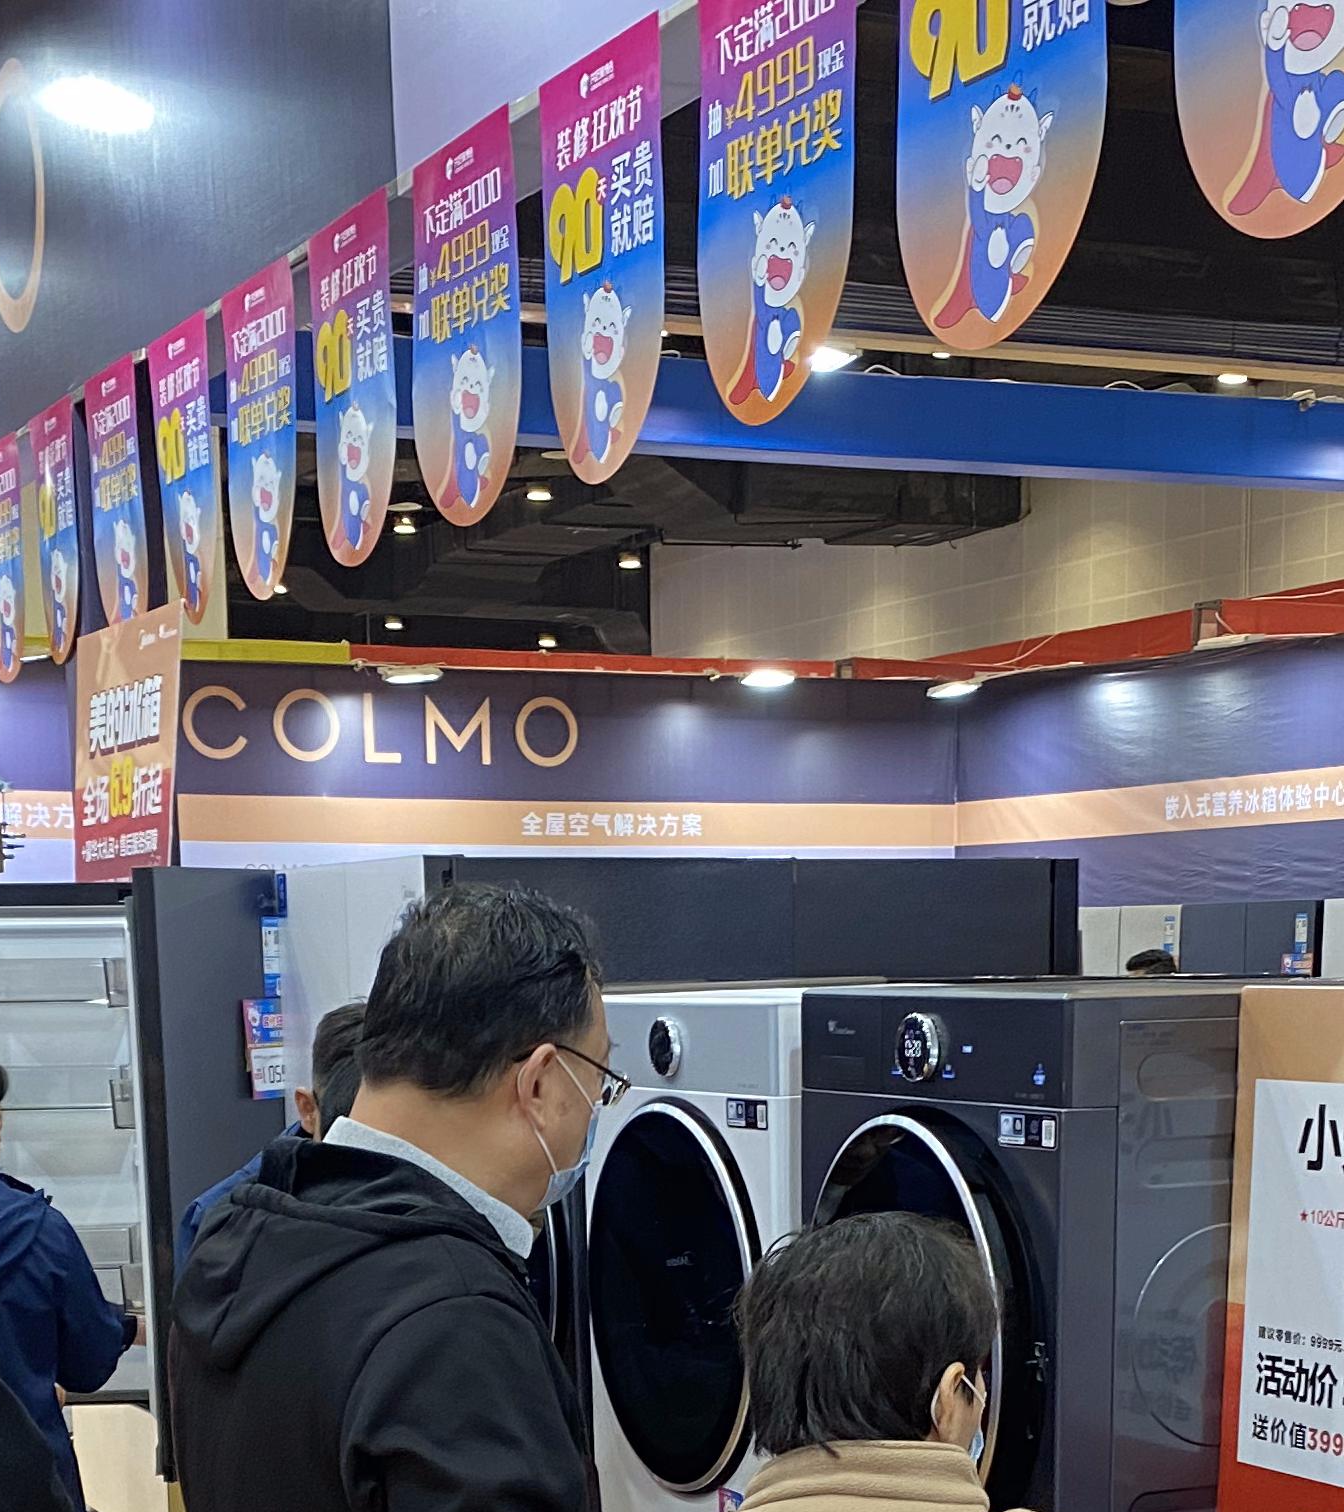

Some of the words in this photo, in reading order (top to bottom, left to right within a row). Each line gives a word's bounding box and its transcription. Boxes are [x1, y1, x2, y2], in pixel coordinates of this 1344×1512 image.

[556, 84, 644, 172] 装修狂欢节
[90, 674, 163, 755] 美的冰箱
[182, 685, 579, 768] COLMO
[81, 756, 163, 827] 全场6.9折起
[521, 811, 703, 838] 全屋空气解决方案
